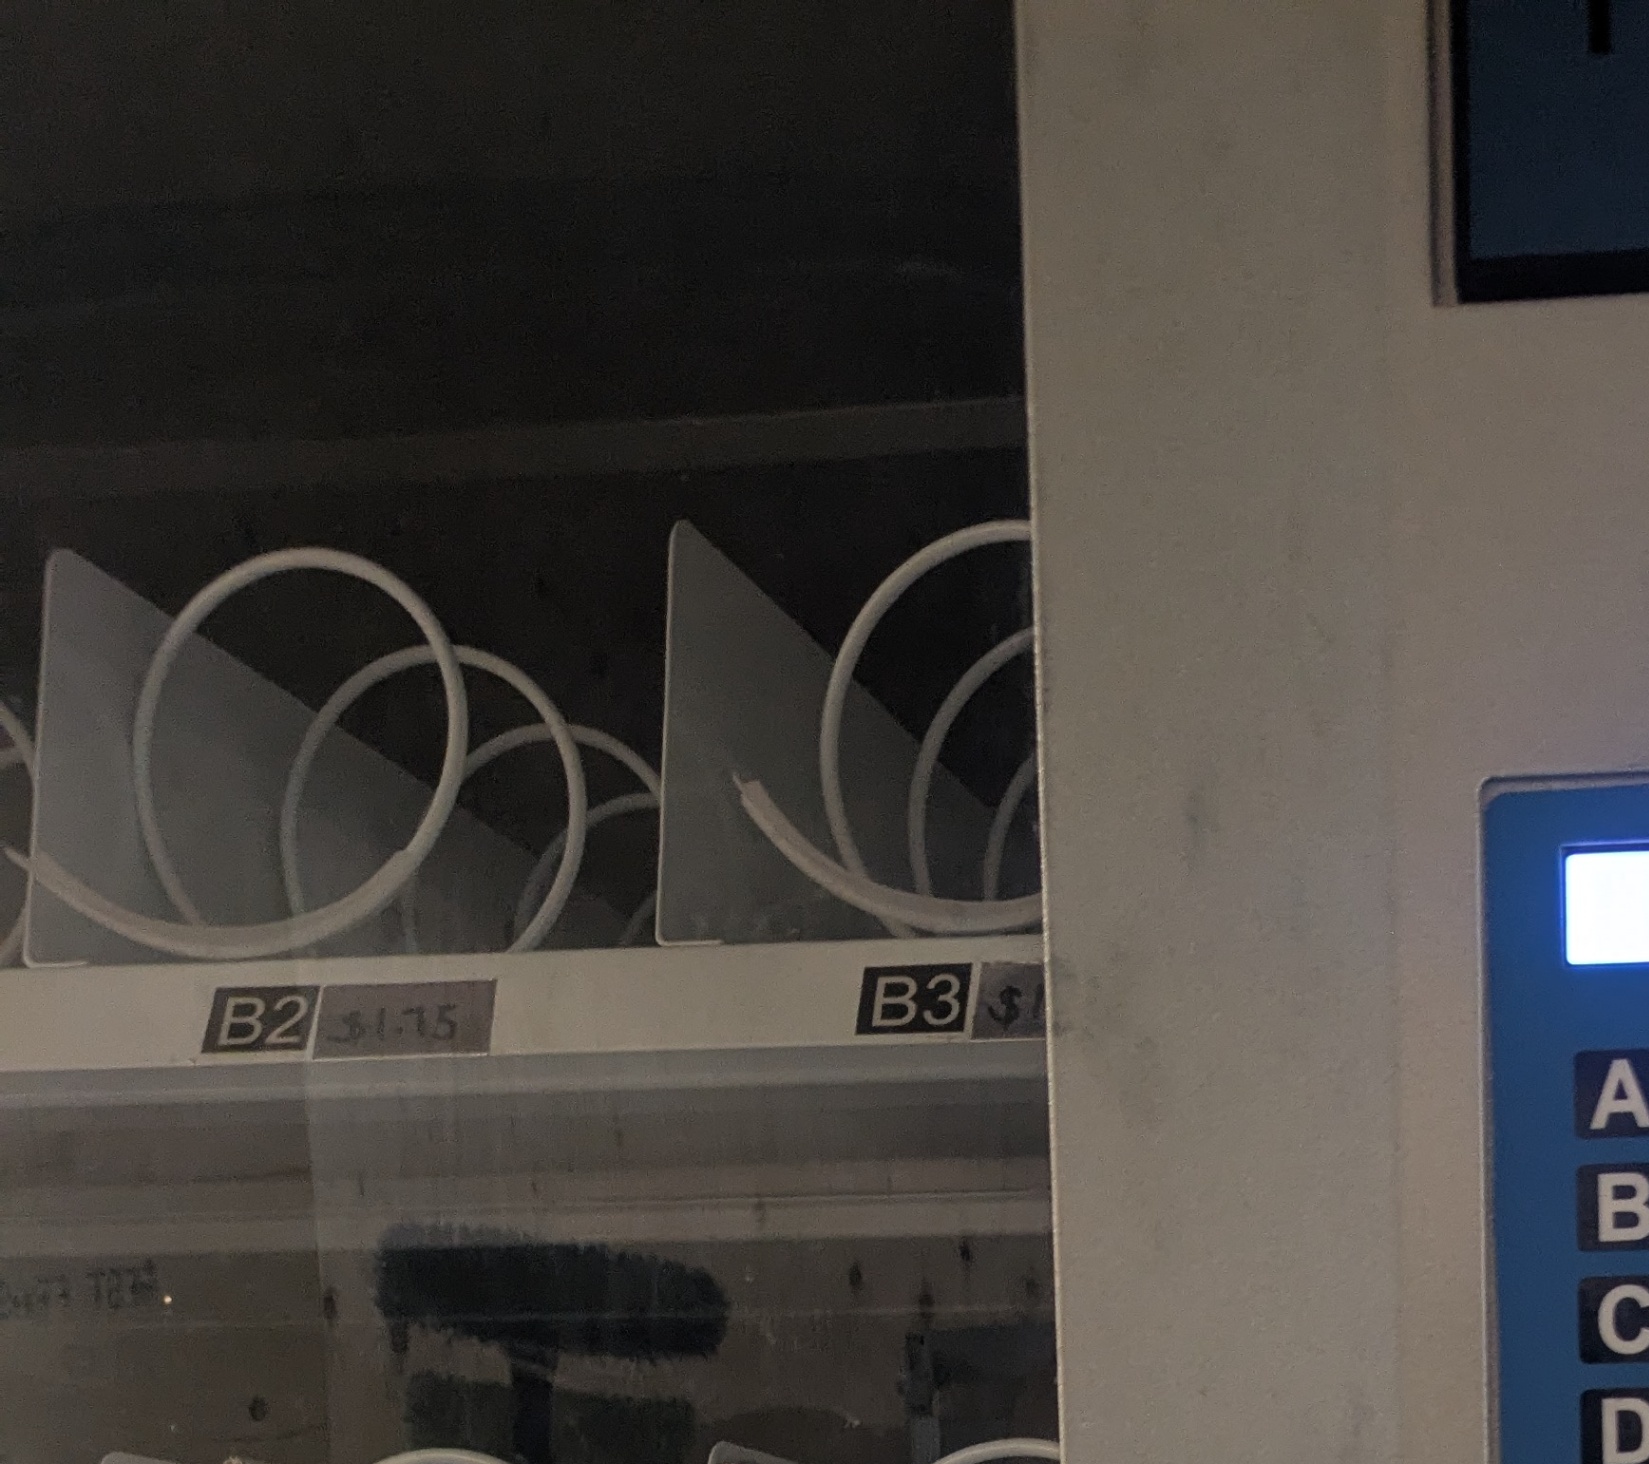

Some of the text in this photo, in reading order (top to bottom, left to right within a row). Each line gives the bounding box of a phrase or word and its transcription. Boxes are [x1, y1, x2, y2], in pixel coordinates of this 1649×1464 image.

[216, 996, 308, 1048] B2
[327, 1003, 458, 1043] $1.75
[871, 973, 960, 1027] B3
